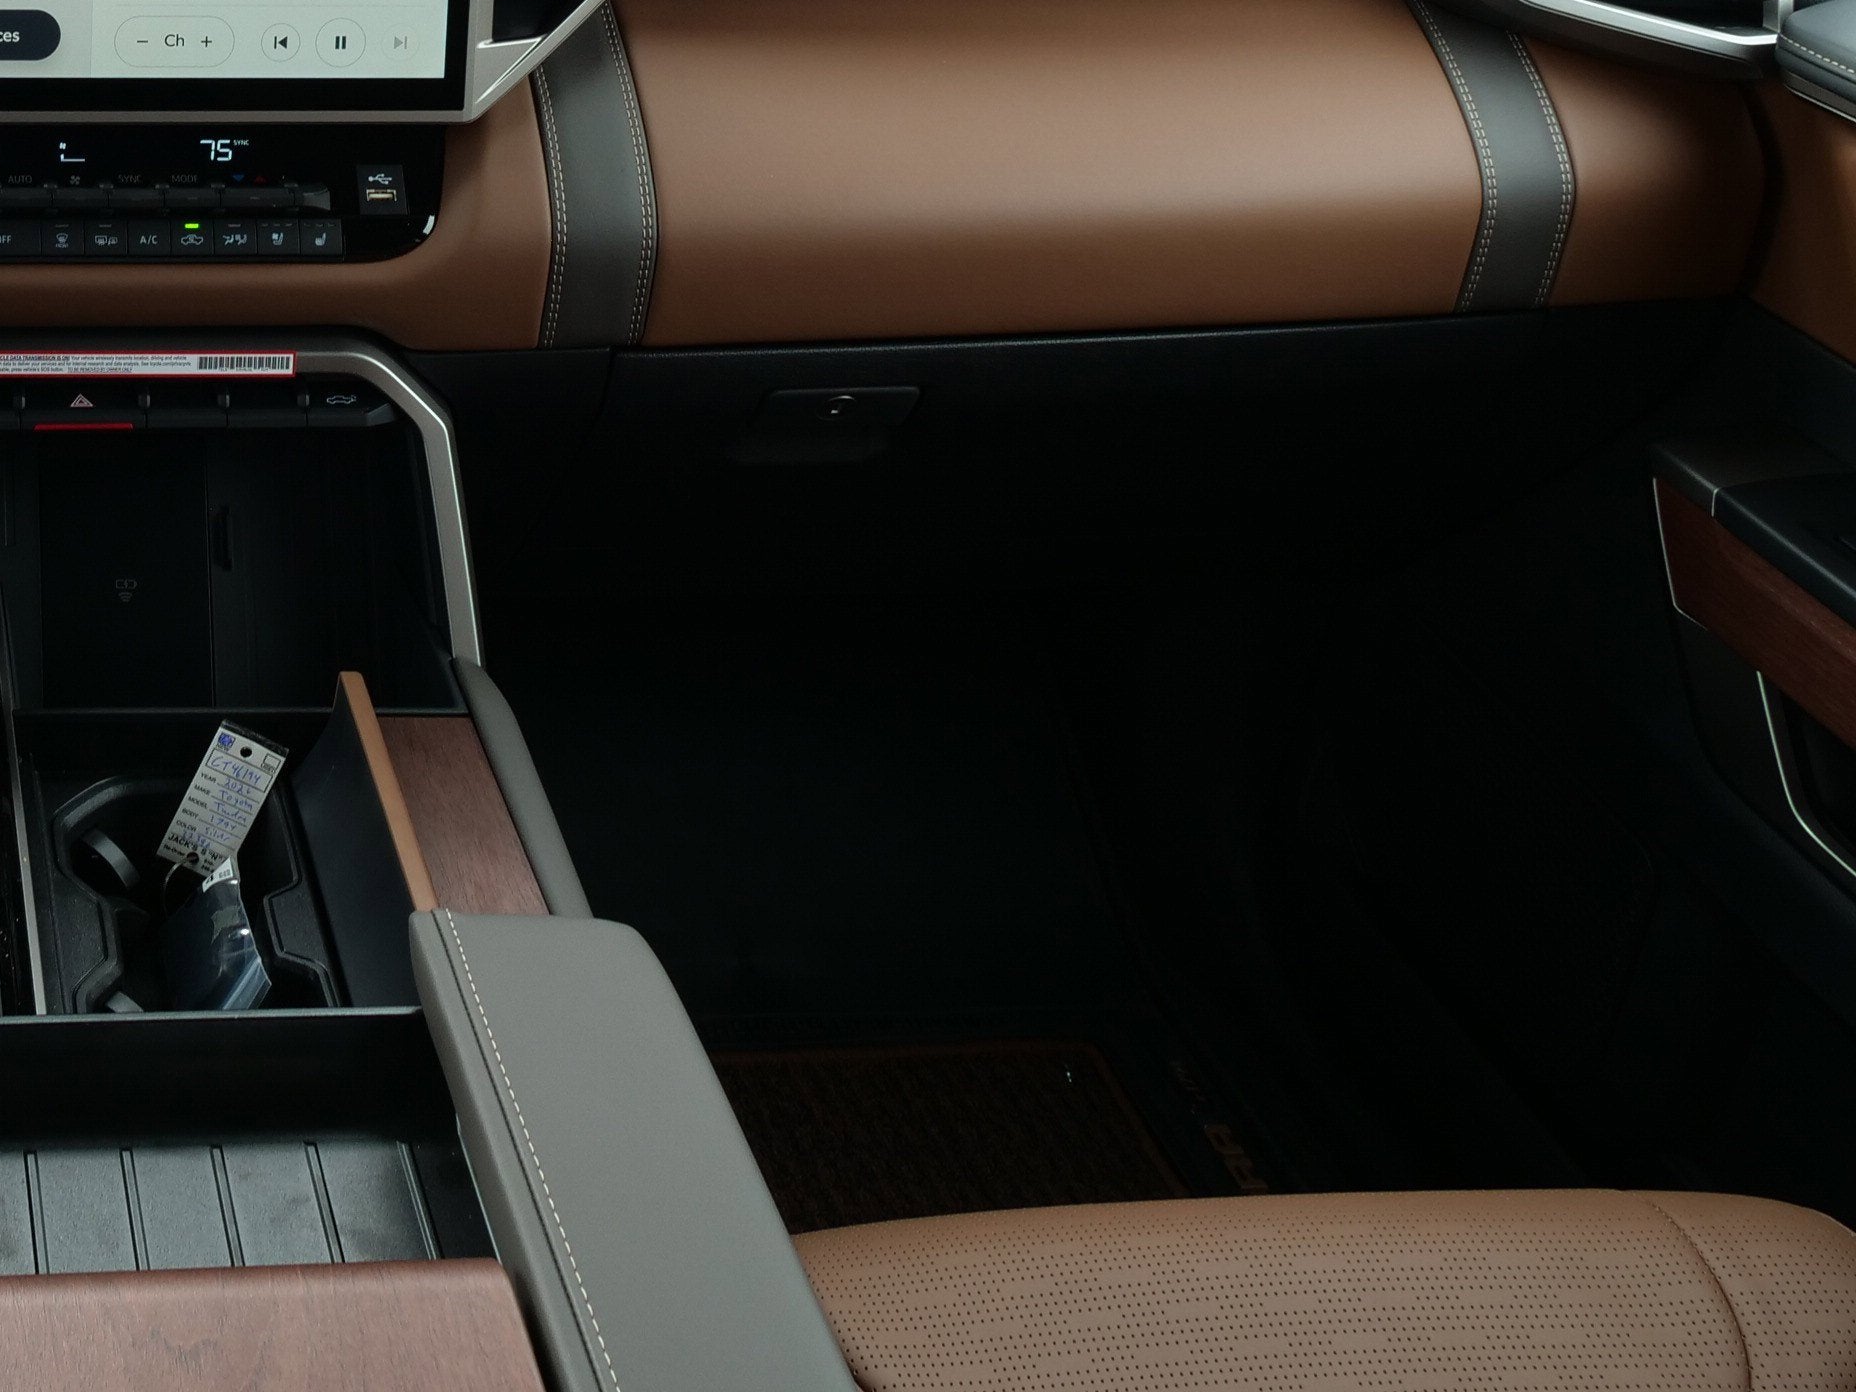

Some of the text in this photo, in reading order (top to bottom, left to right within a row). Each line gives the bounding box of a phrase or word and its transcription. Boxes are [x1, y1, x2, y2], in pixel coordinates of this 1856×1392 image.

[164, 34, 185, 47] Ch
[200, 139, 233, 161] 75
[8, 175, 33, 184] AUTO
[118, 174, 143, 183] SYNC
[171, 174, 198, 183] MODE
[139, 234, 158, 244] A/C
[211, 756, 261, 784] CT46194
[201, 773, 216, 783] YEAR
[194, 785, 210, 795] MAKE
[188, 796, 207, 809] MODEL
[182, 808, 199, 818] BODY
[176, 820, 196, 832] COLOR
[168, 834, 198, 851] JACK'S
